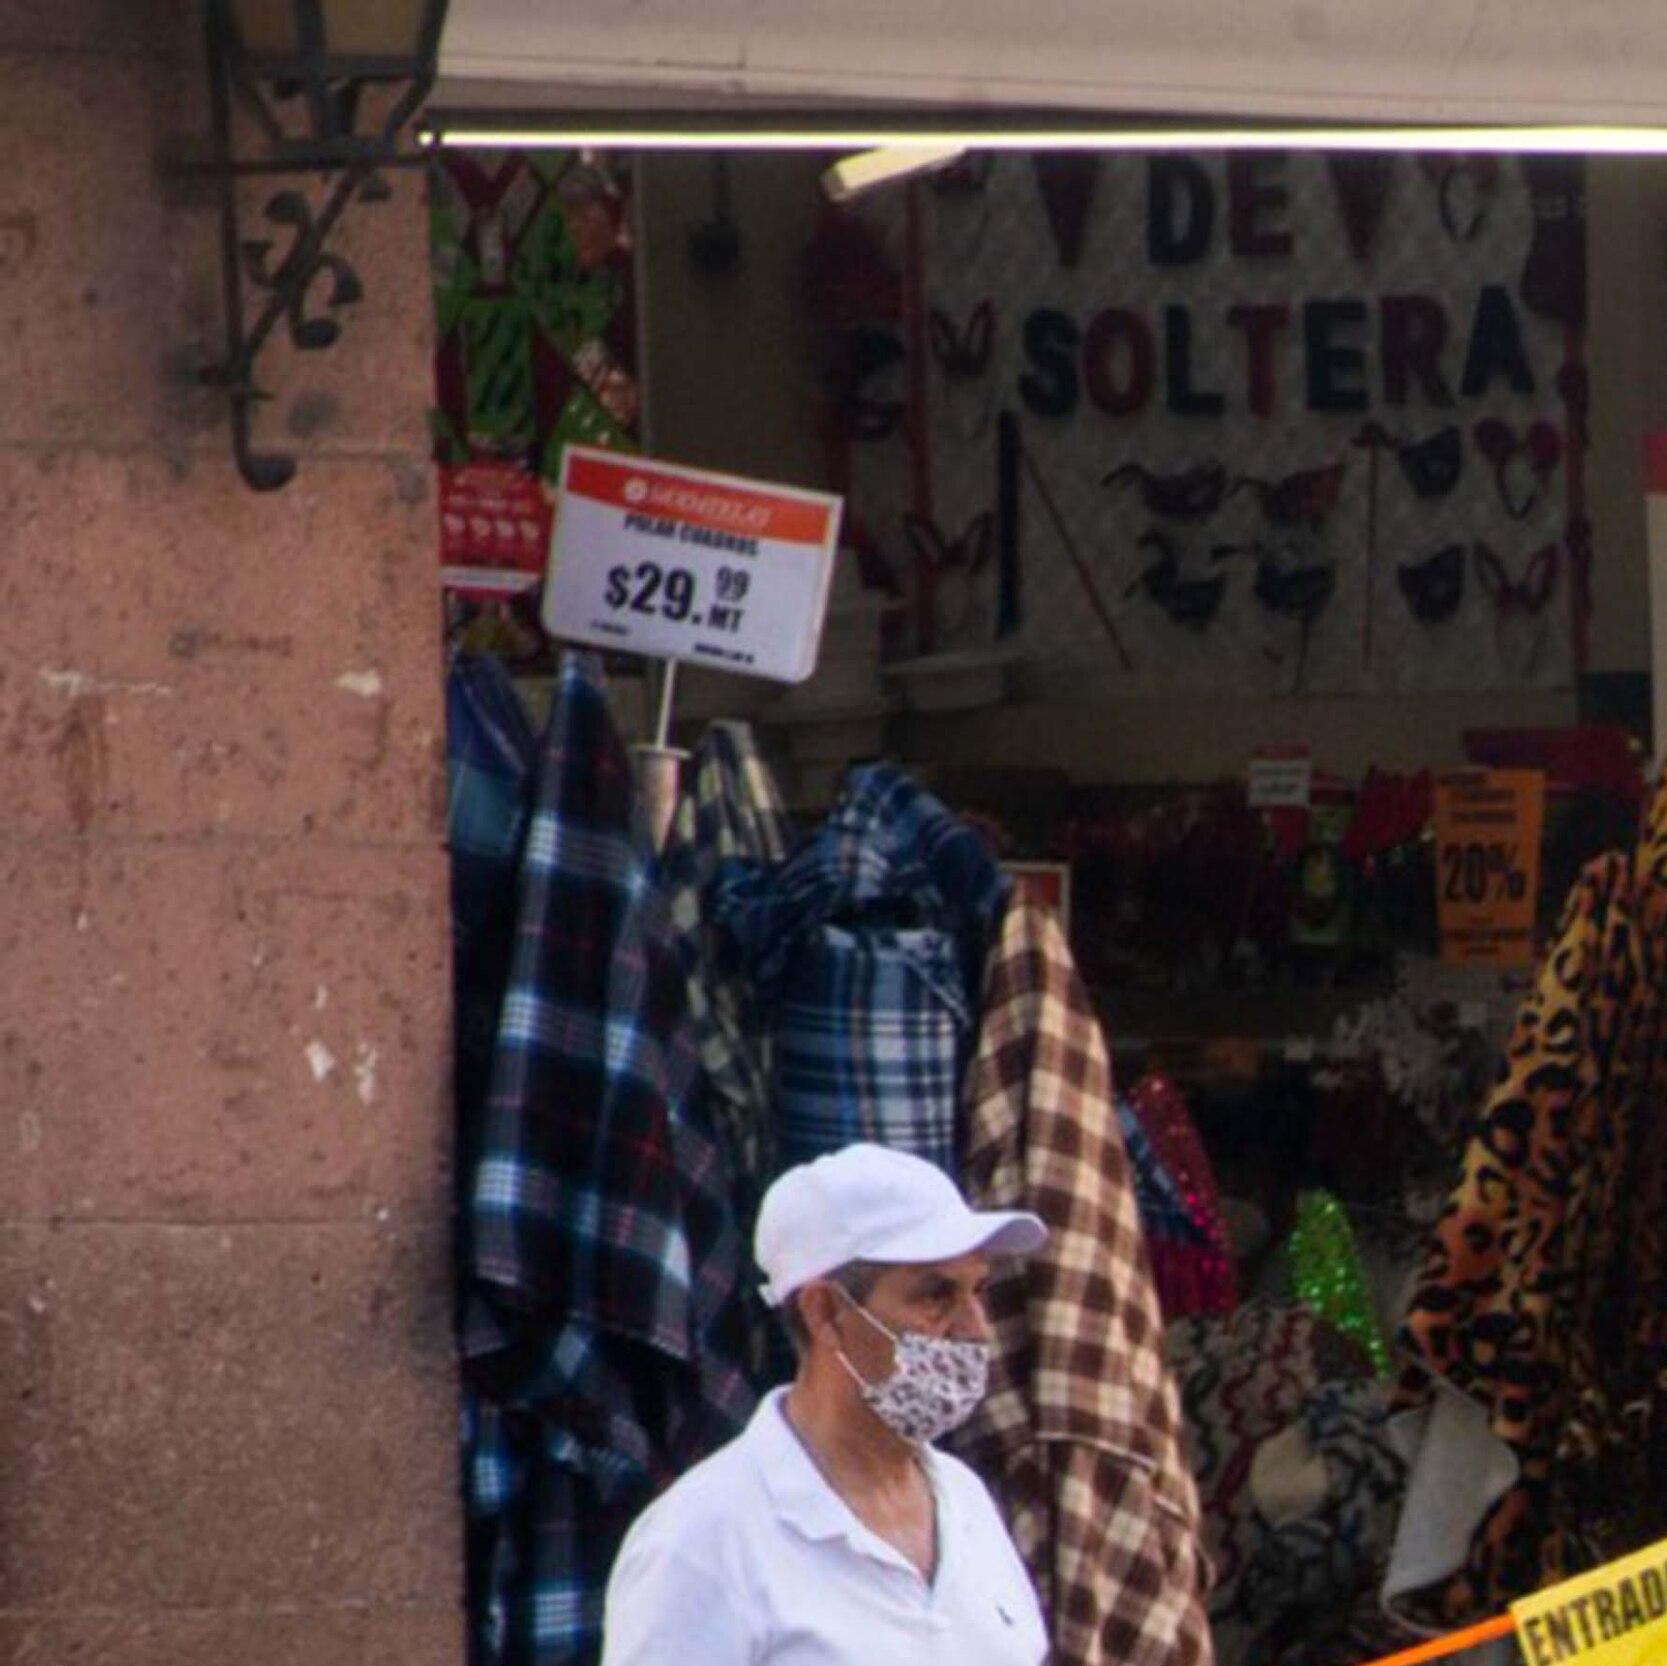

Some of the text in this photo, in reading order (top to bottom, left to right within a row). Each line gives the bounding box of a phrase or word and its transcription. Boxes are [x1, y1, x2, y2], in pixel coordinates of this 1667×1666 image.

[1146, 153, 1294, 266] DE
[1018, 283, 1536, 418] SOLTERA
[625, 514, 758, 557] POLAR CUADROS
[706, 604, 746, 633] MT
[1444, 842, 1526, 904] 20%
